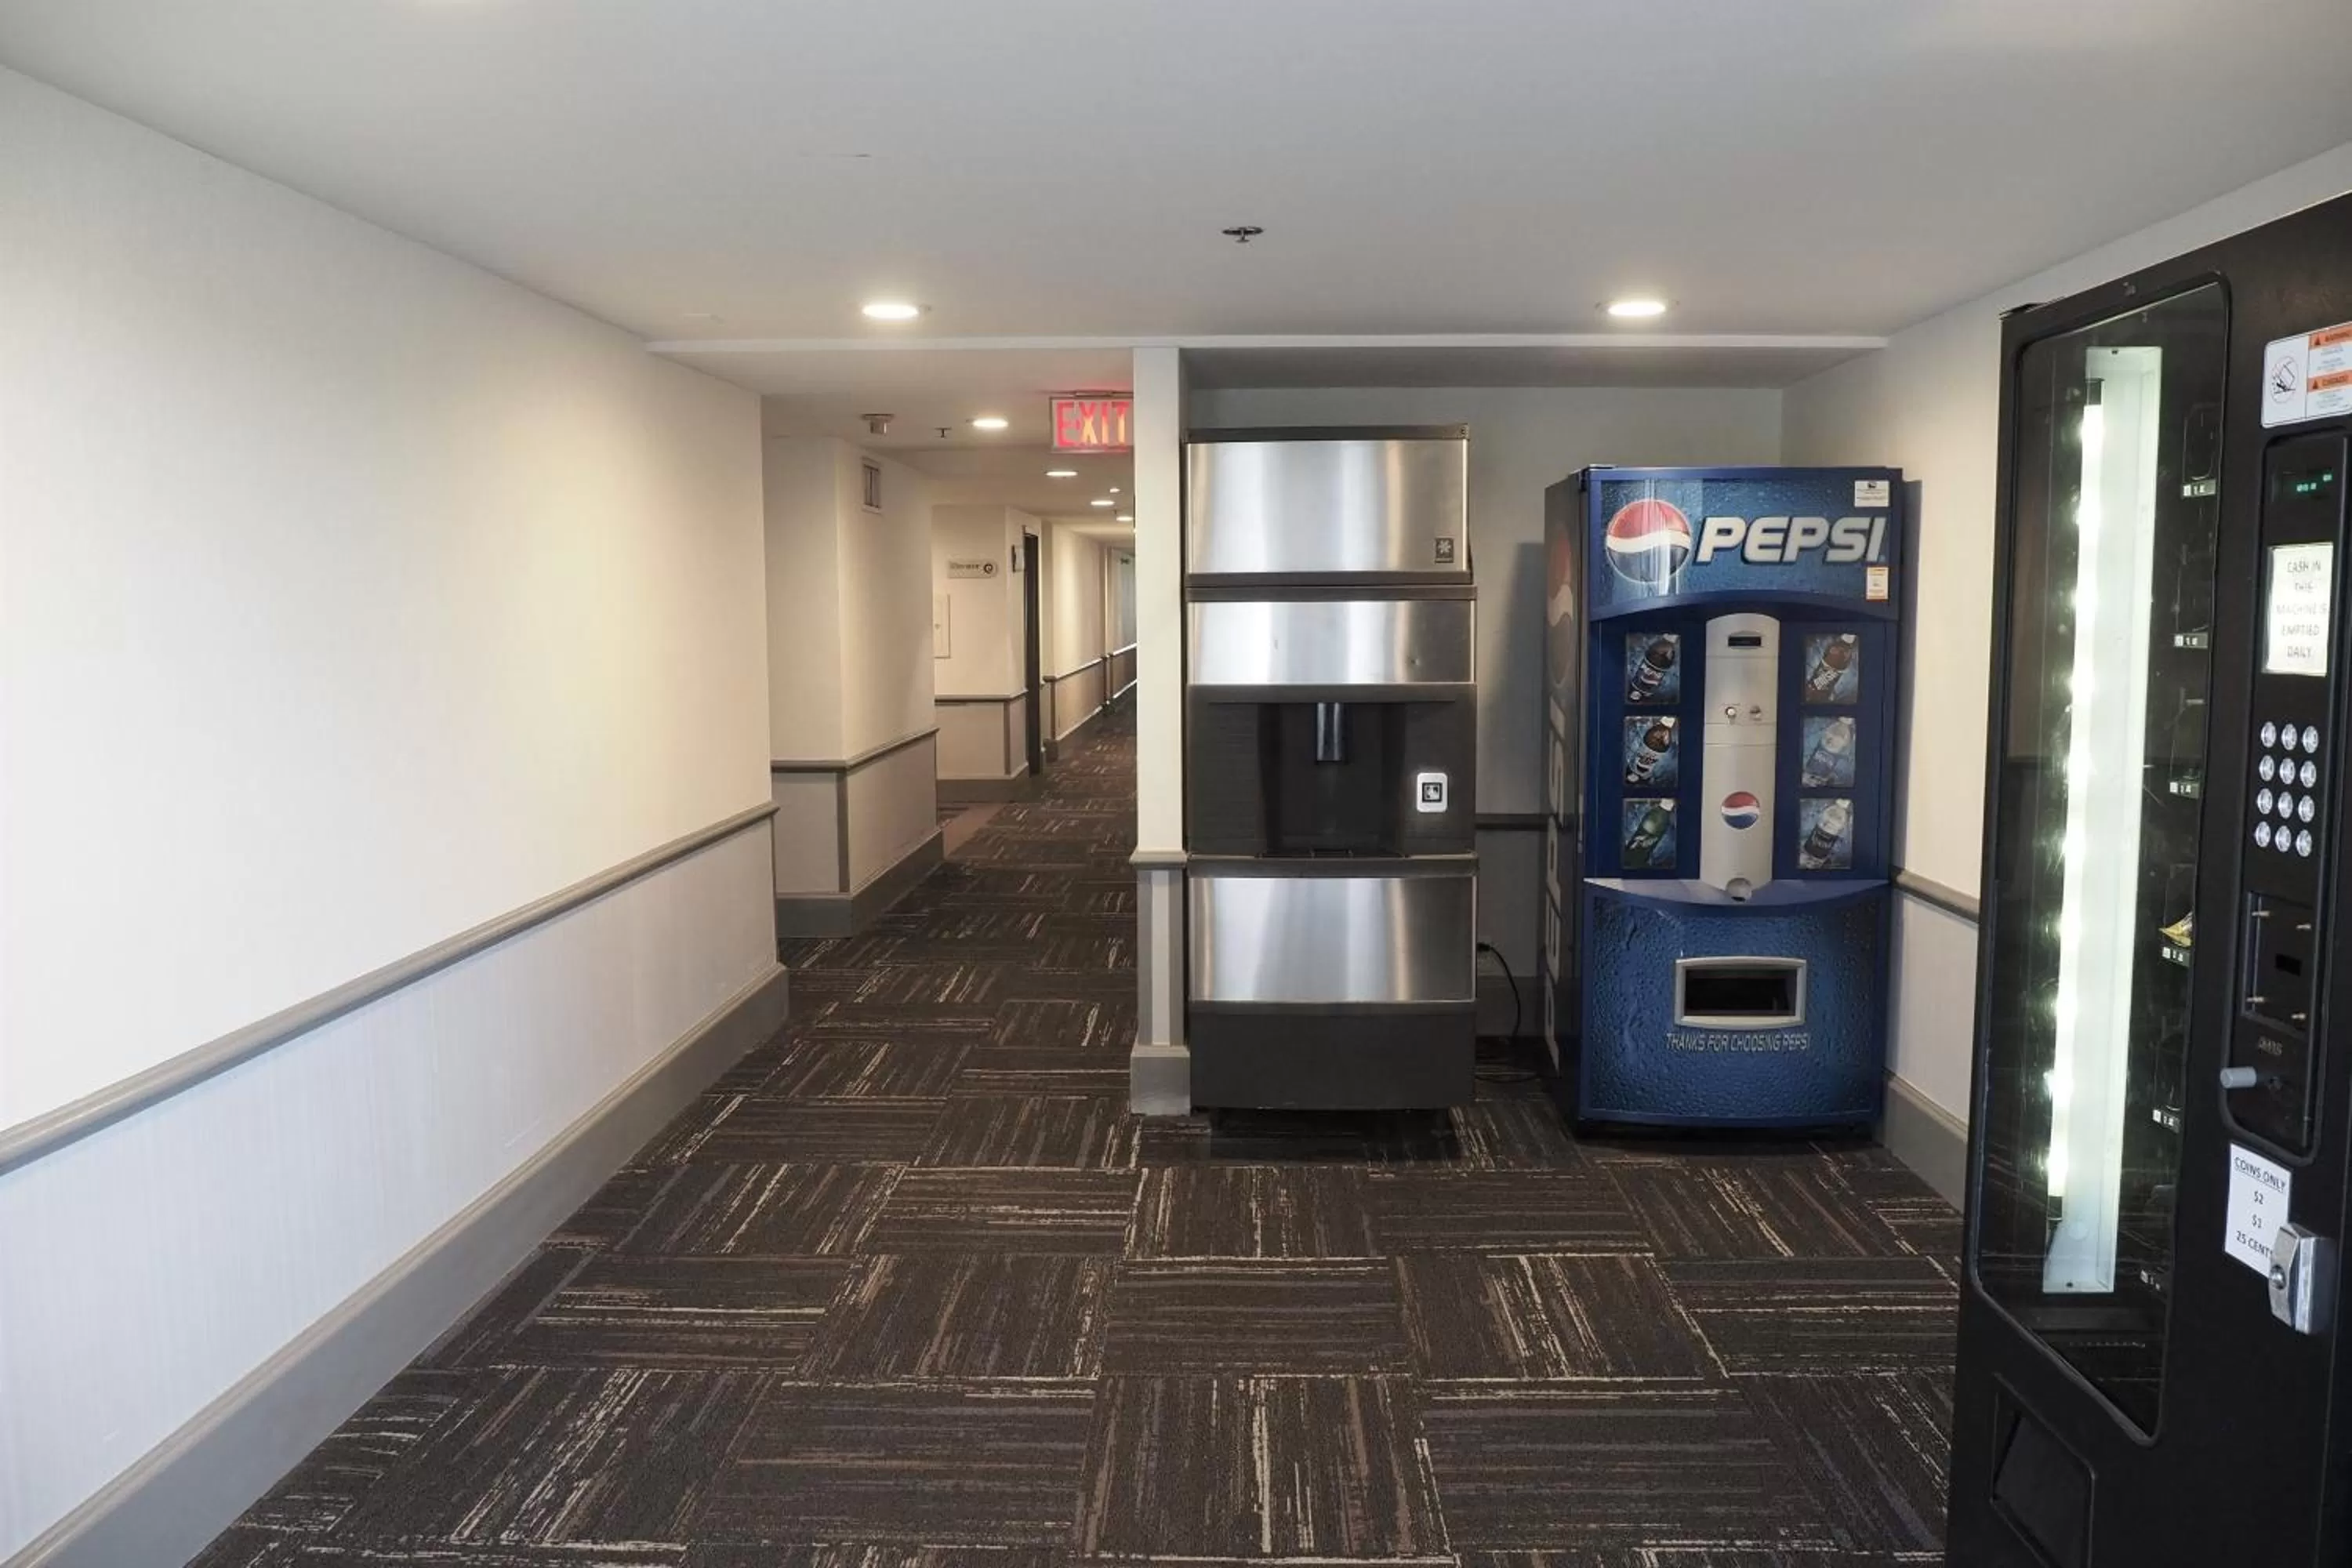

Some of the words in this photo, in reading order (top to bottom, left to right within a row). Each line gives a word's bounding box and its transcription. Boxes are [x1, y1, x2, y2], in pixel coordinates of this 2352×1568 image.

[1056, 401, 1130, 448] EXIT
[1696, 517, 1886, 562] PEPSI
[1666, 1033, 1704, 1052] THANKS
[1708, 1034, 1729, 1051] FOR
[1730, 1034, 1782, 1051] CHOOSING
[2234, 1156, 2261, 1180] COINS
[2263, 1171, 2285, 1191] ONLY
[2253, 1191, 2263, 1205] $2
[2236, 1230, 2246, 1245] 25
